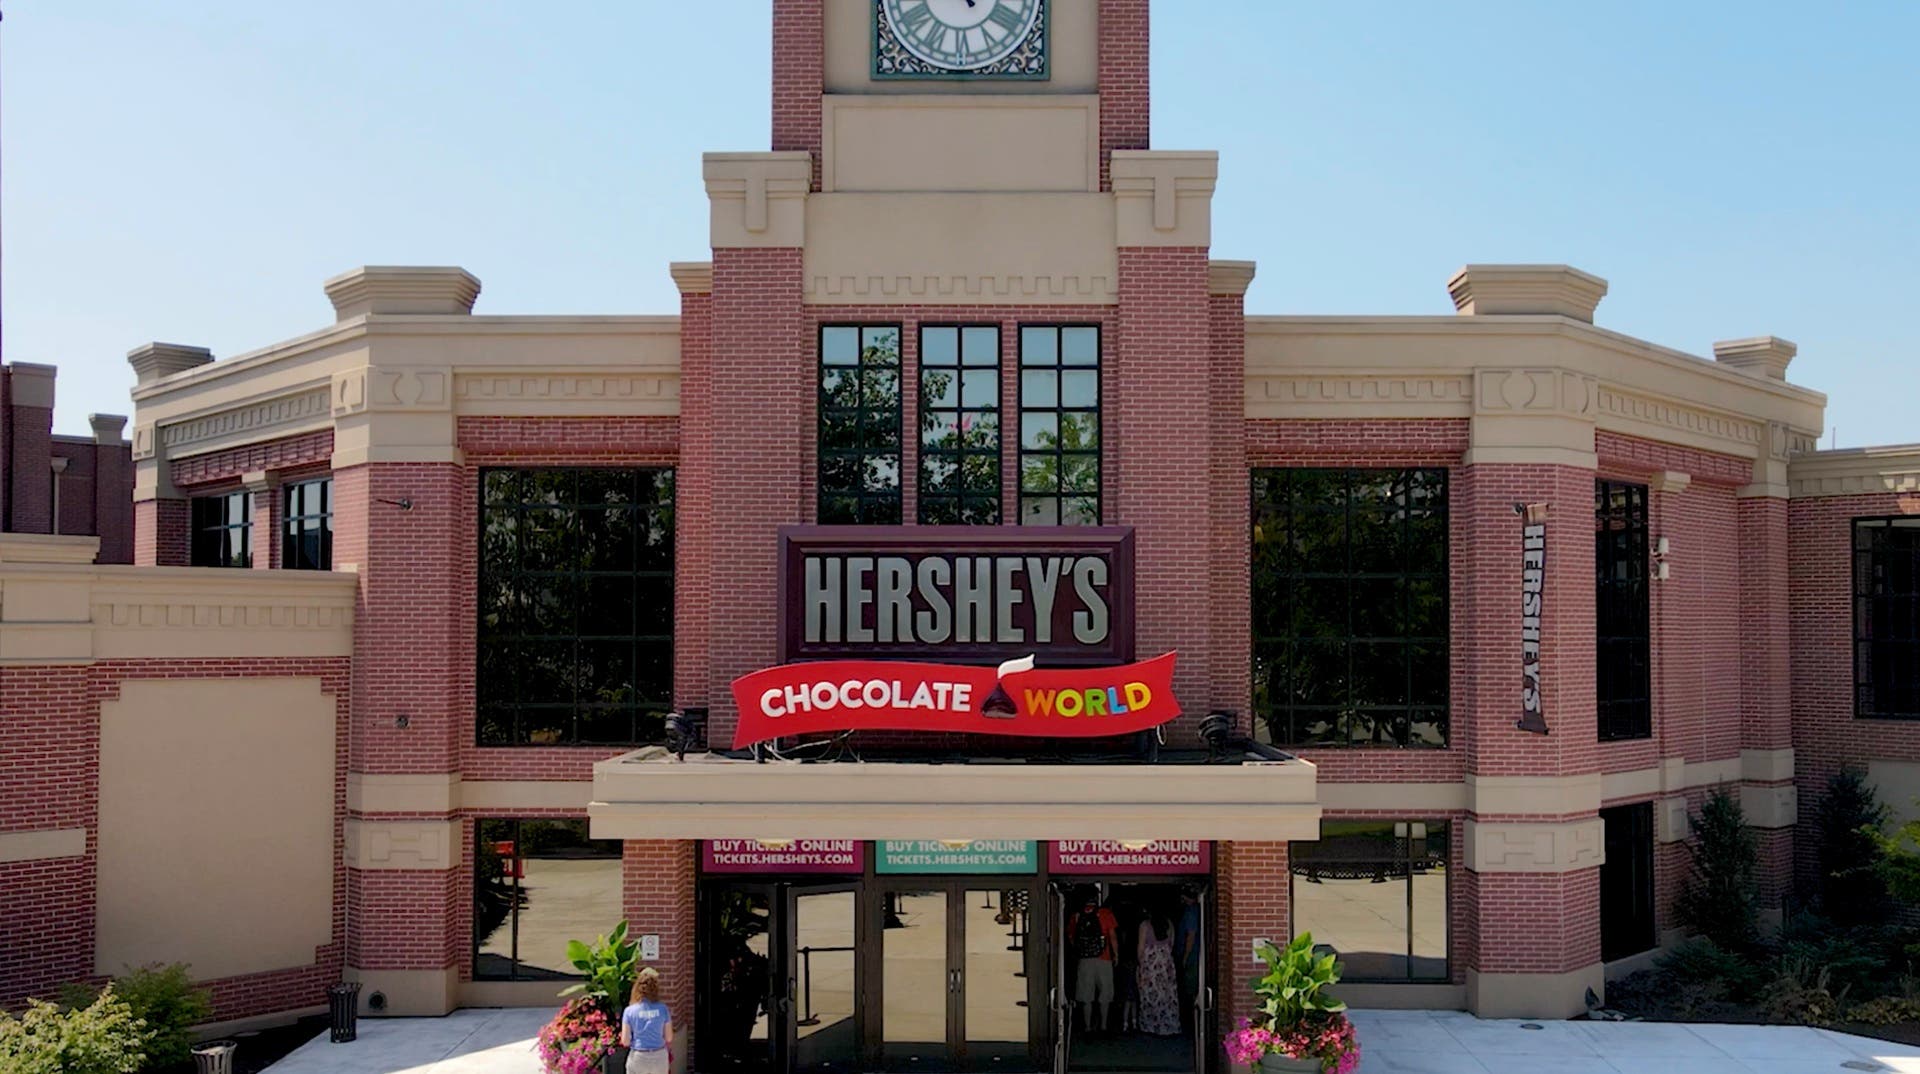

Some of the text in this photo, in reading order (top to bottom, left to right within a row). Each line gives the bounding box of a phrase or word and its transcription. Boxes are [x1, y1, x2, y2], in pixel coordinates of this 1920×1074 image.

[804, 556, 1108, 644] HERSHEY'S
[760, 678, 1151, 718] CHOCOLATE WORLD
[713, 840, 741, 852] BUY
[800, 840, 854, 852] ONLINE
[886, 840, 913, 852] BUY
[974, 840, 1027, 852] ONLINE
[1059, 840, 1087, 852] BUY
[1149, 840, 1200, 852] ONLINE
[713, 854, 854, 864] TICKETS.HERSHEYS.COM
[886, 854, 1027, 865] TICKETS.HERSHEYS.COM
[1060, 854, 1200, 865] TICKETS.HERSHEYS.COM
